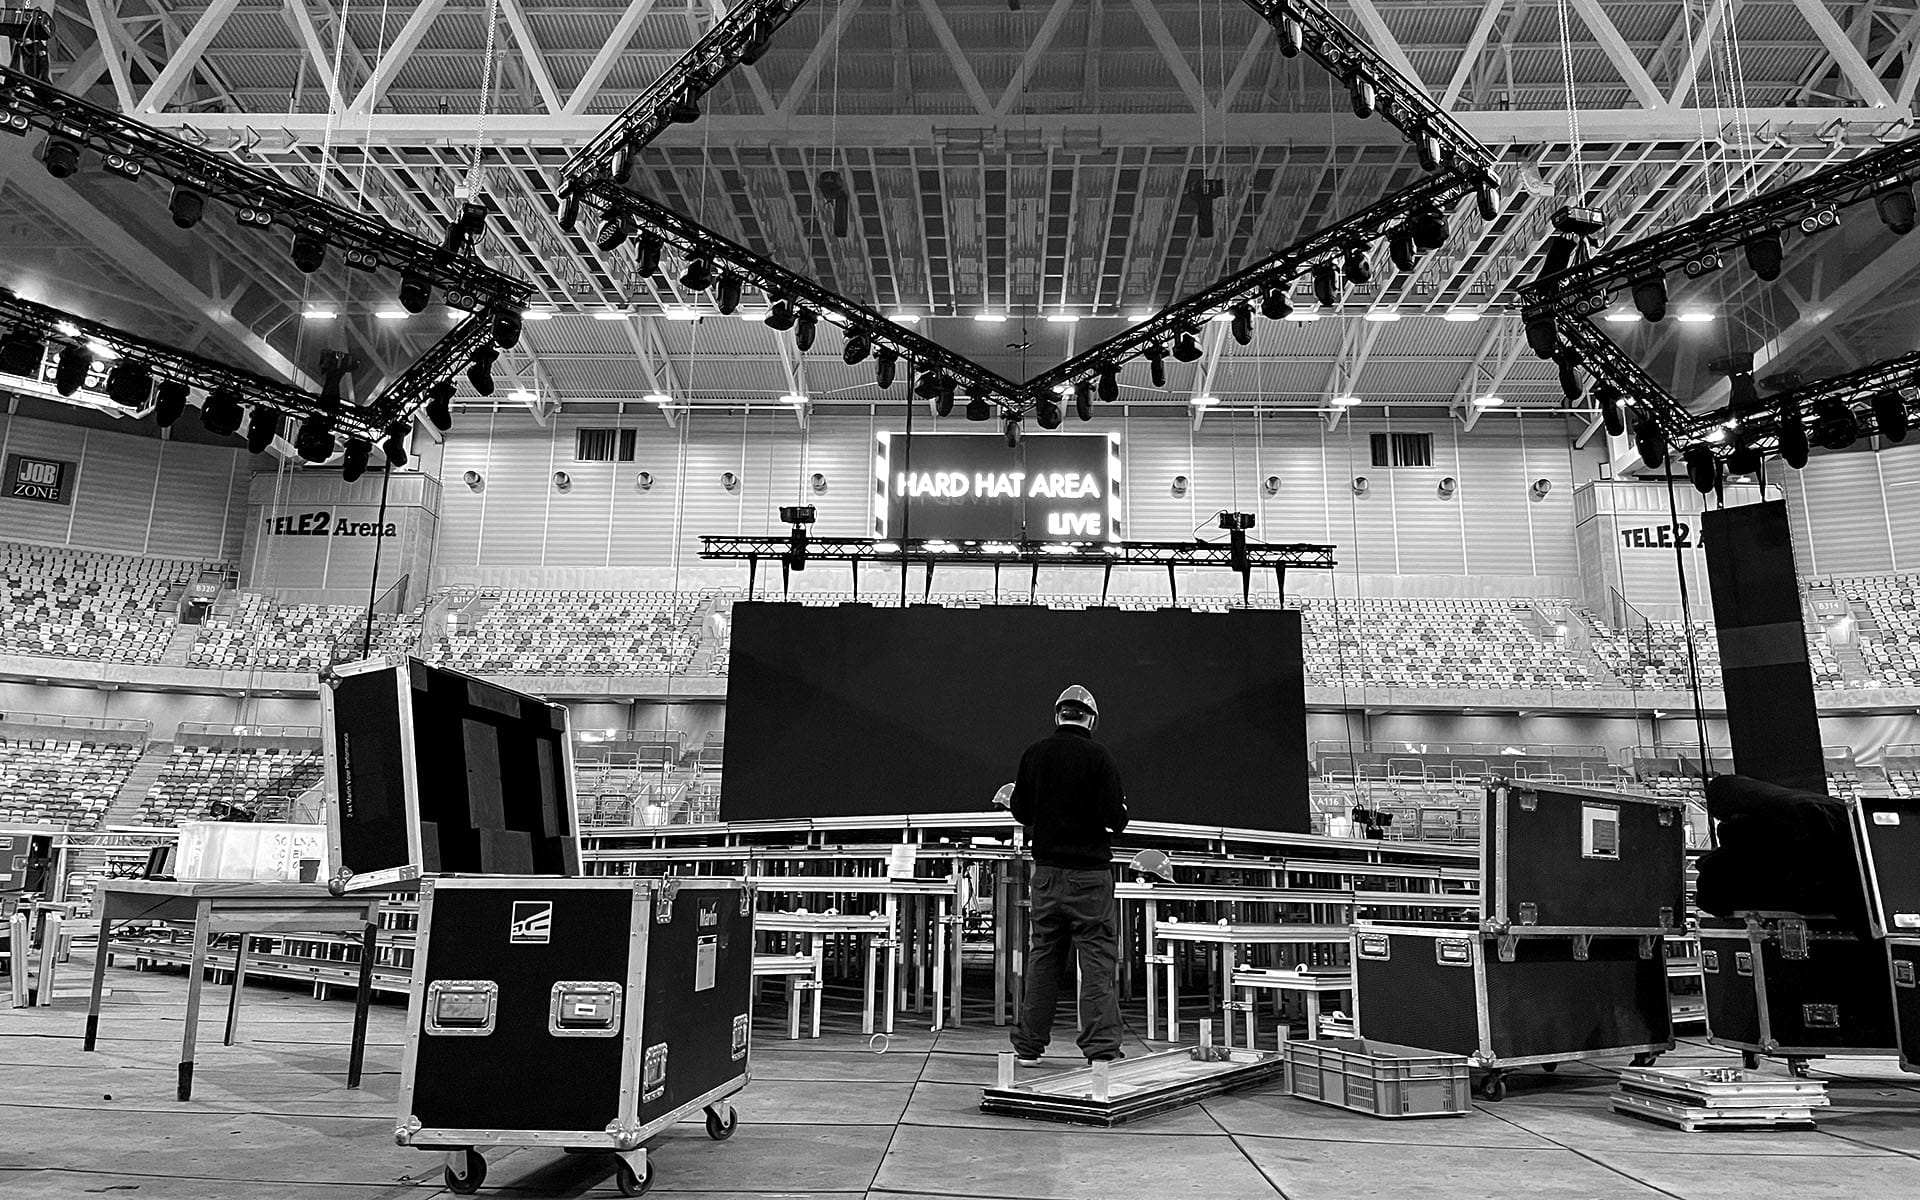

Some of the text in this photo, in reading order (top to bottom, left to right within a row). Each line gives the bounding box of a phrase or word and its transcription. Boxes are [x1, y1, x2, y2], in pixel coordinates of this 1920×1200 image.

[20, 462, 56, 484] JOB
[897, 471, 1100, 498] HARD HAT AREA
[14, 484, 59, 499] ZONE
[266, 511, 396, 537] TELE2 Arena
[1048, 512, 1100, 536] LIVE
[1621, 523, 1692, 548] TELE2
[654, 786, 677, 795] A118
[1316, 797, 1340, 806] A116
